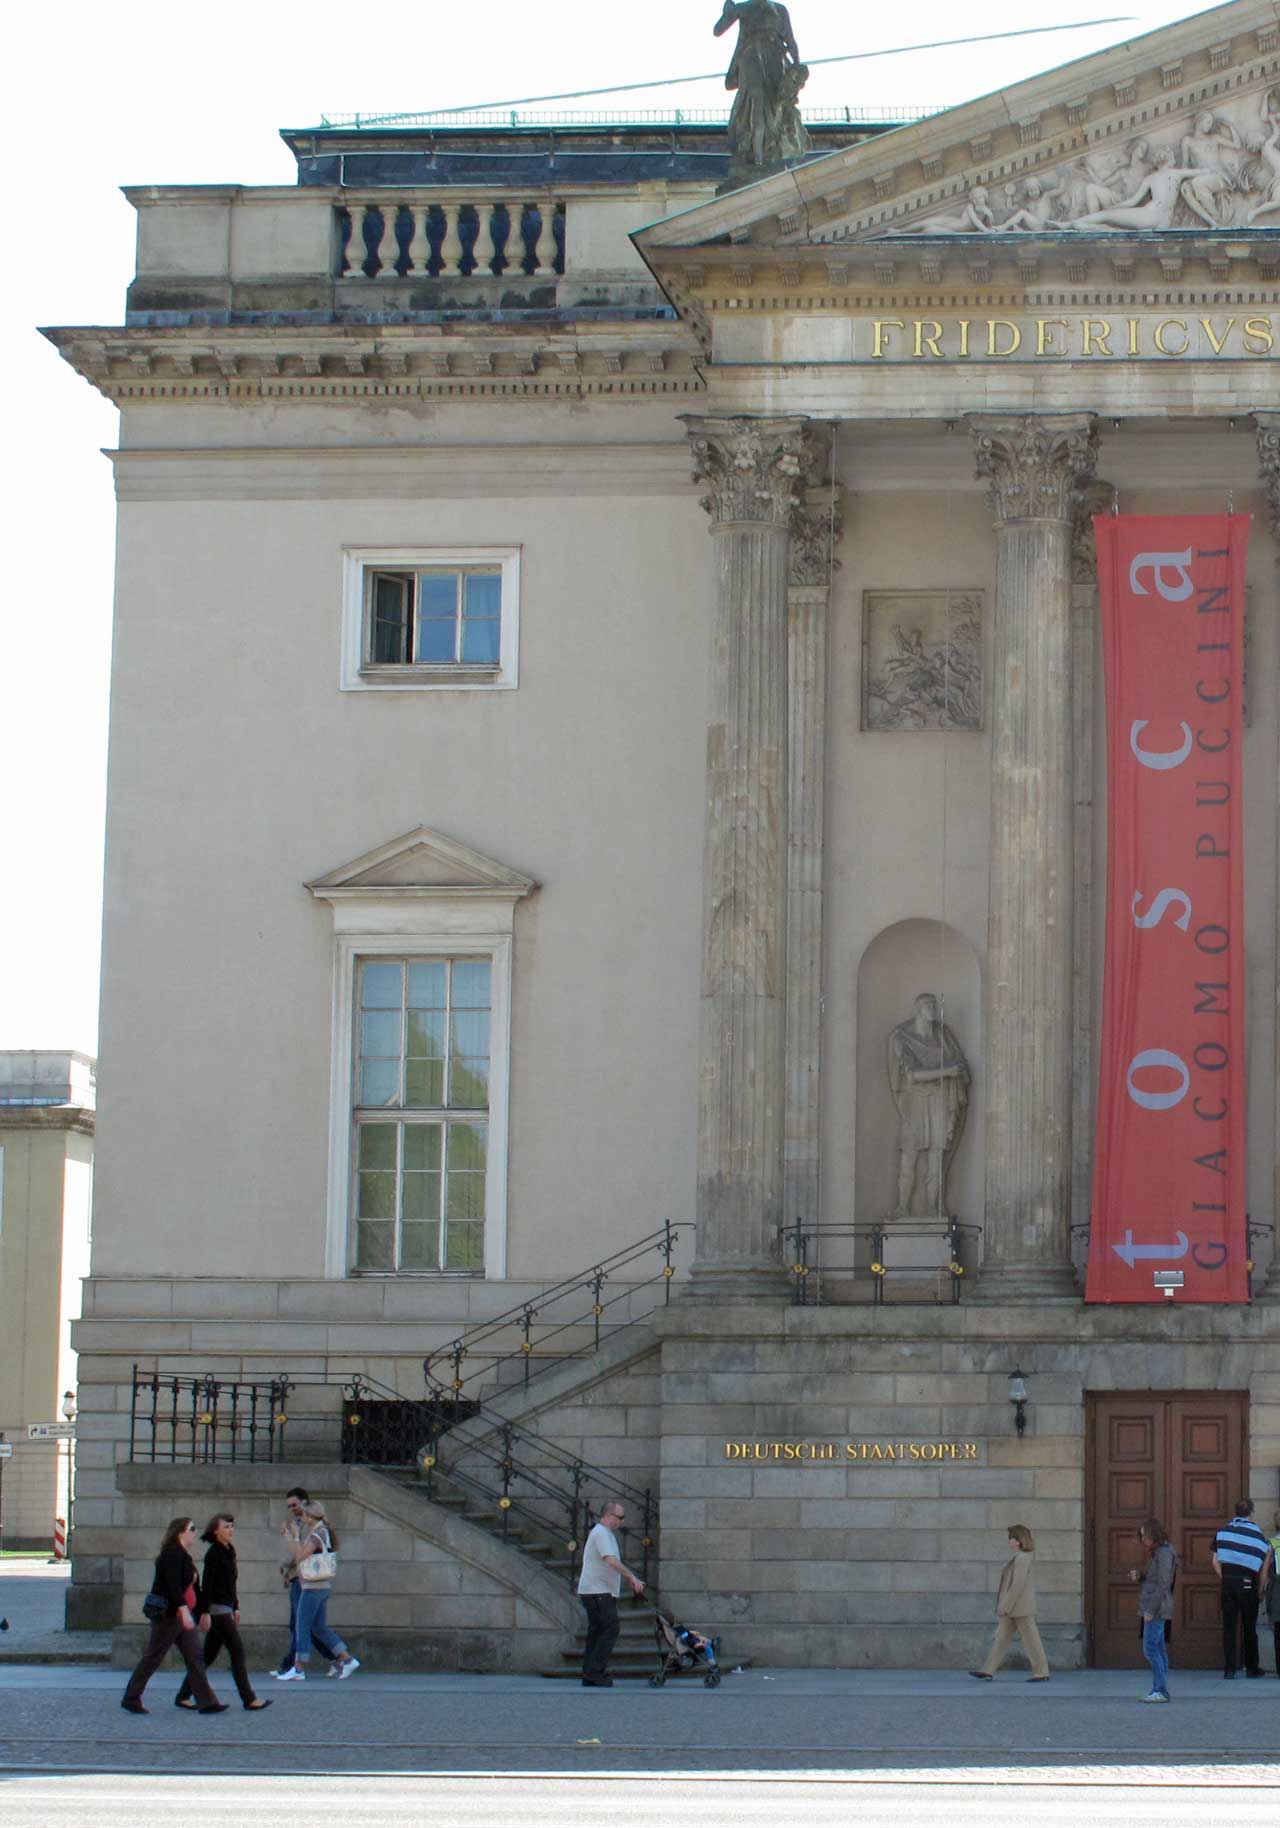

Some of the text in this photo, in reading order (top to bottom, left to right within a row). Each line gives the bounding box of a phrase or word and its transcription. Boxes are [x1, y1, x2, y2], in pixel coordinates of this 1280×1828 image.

[871, 317, 1275, 359] FRIDERICVS
[1111, 546, 1193, 1269] tosca
[1192, 546, 1232, 1272] GIACOMO PUCCINI
[725, 1443, 978, 1460] DEUTSCHE STAATSOPER
